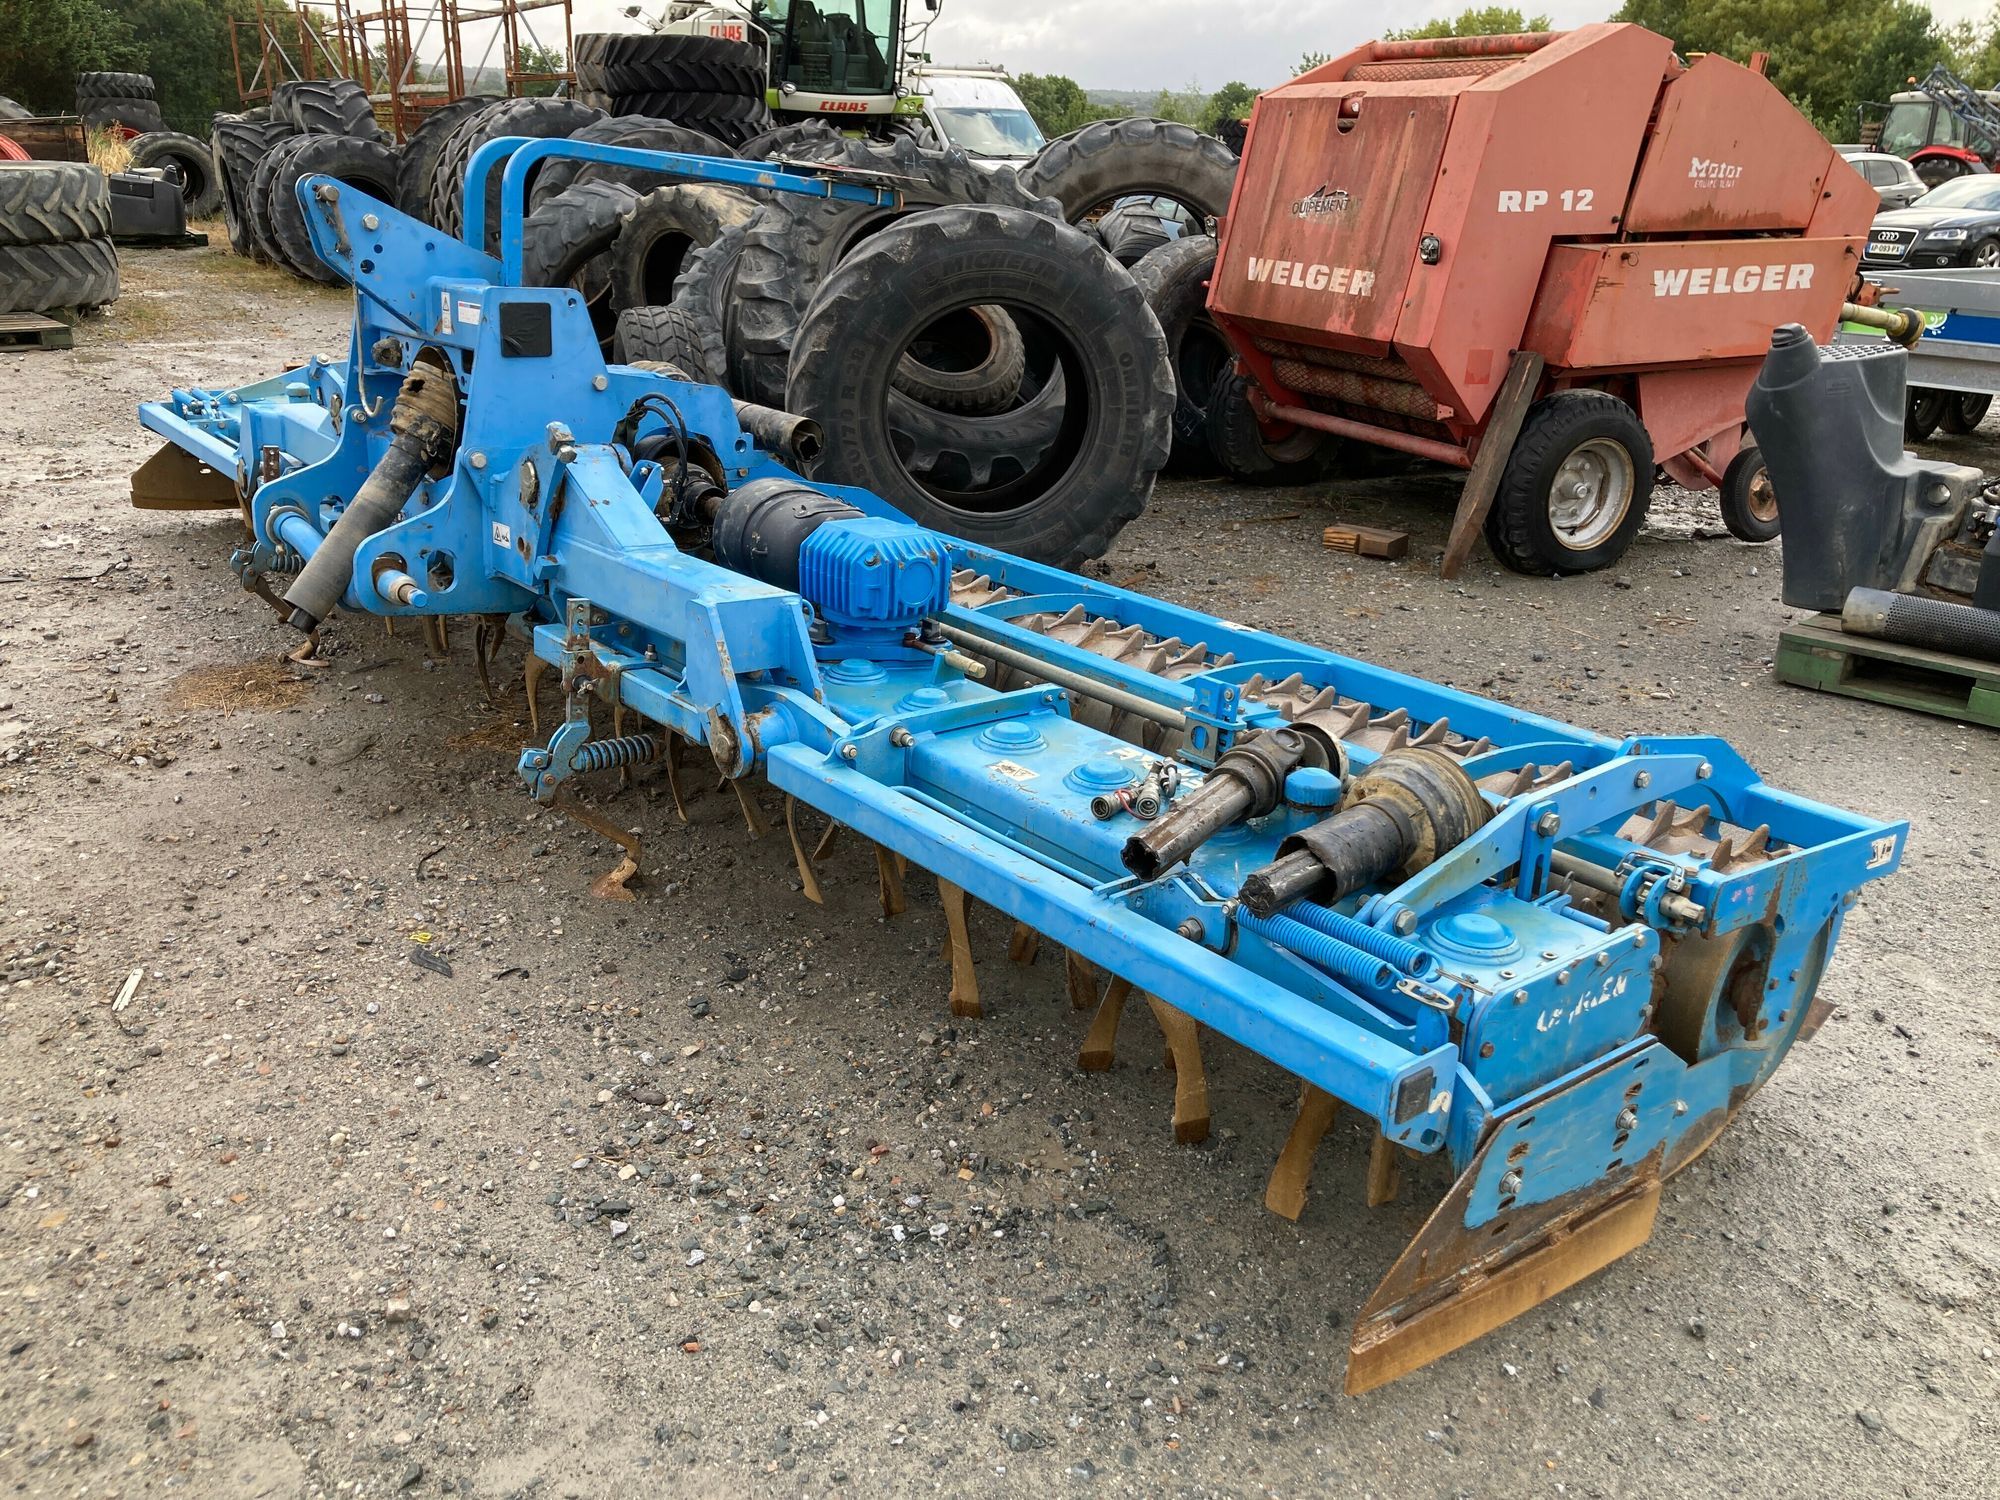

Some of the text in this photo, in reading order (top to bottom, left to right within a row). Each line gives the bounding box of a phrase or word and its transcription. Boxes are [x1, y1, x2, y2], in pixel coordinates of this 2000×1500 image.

[819, 101, 868, 113] CLAAS
[1688, 157, 1743, 179] Motor
[1497, 189, 1594, 213] RP 12
[1247, 256, 1376, 297] WELGER
[1653, 263, 1815, 297] WELGER
